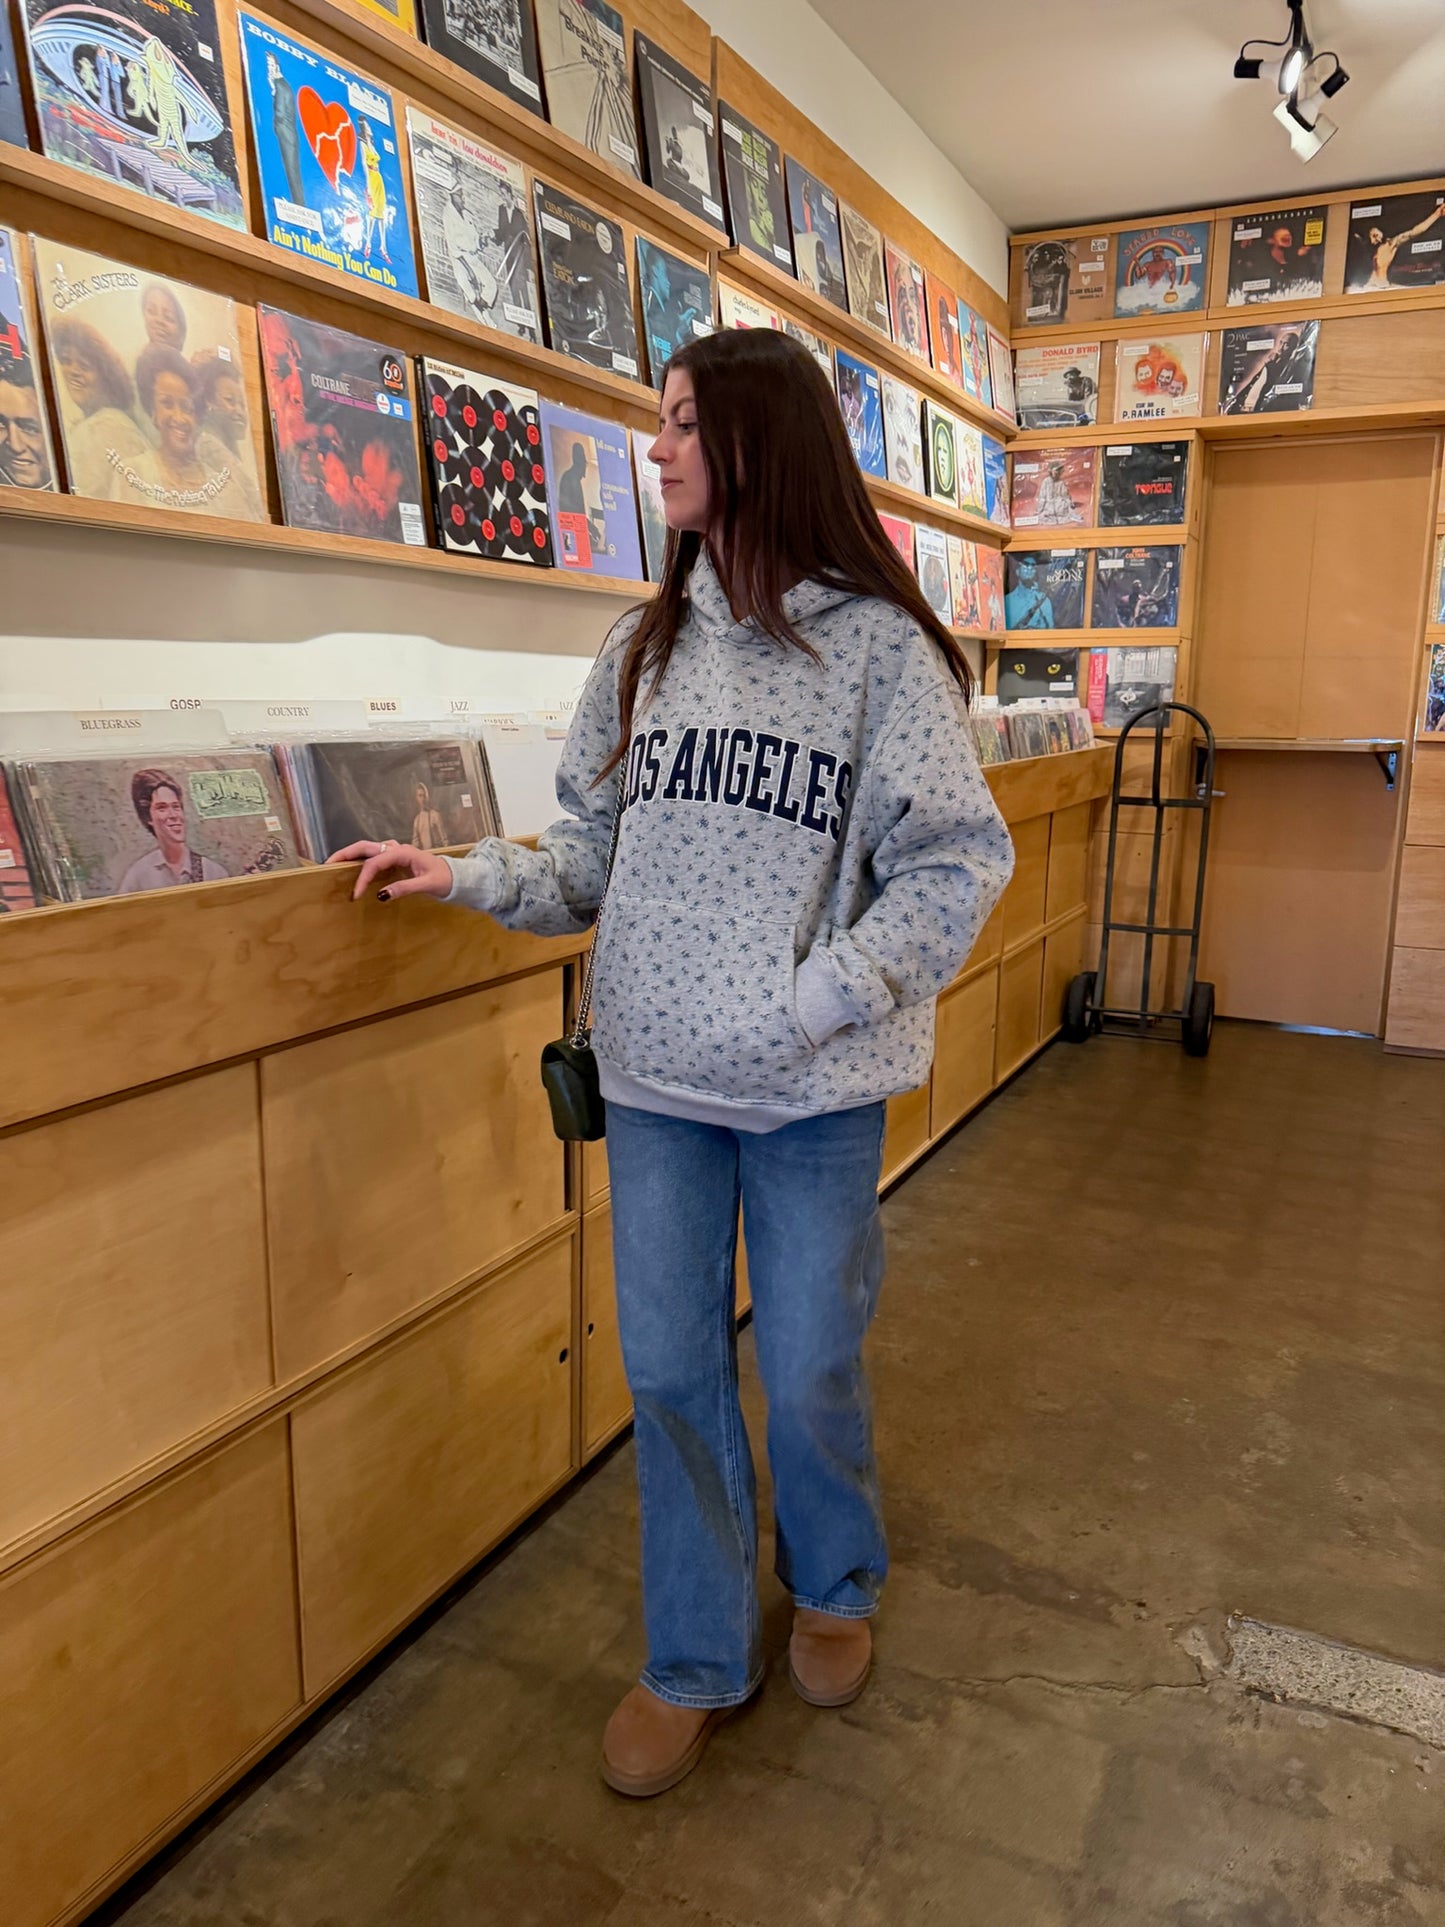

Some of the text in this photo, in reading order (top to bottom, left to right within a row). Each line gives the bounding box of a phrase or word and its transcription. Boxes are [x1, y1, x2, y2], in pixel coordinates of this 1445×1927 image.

[246, 21, 319, 68] BOBBY
[273, 224, 397, 288] Ain't Nothing You Can Do
[53, 272, 139, 311] CLARK SISTERS
[1042, 345, 1099, 357] DONALD BYRD
[383, 360, 402, 383] 60
[311, 373, 351, 396] COLTRANE
[1122, 407, 1166, 419] P.RAMLEE
[170, 488, 208, 507] Nothing
[1046, 574, 1083, 583] ROLLINS
[1054, 568, 1083, 576] SONNY
[267, 706, 309, 717] COUNTRY
[370, 701, 397, 711] BLUES
[450, 701, 469, 713] JAZZ
[80, 718, 142, 731] BLUEGRASS
[620, 726, 853, 843] OS ANGELES
